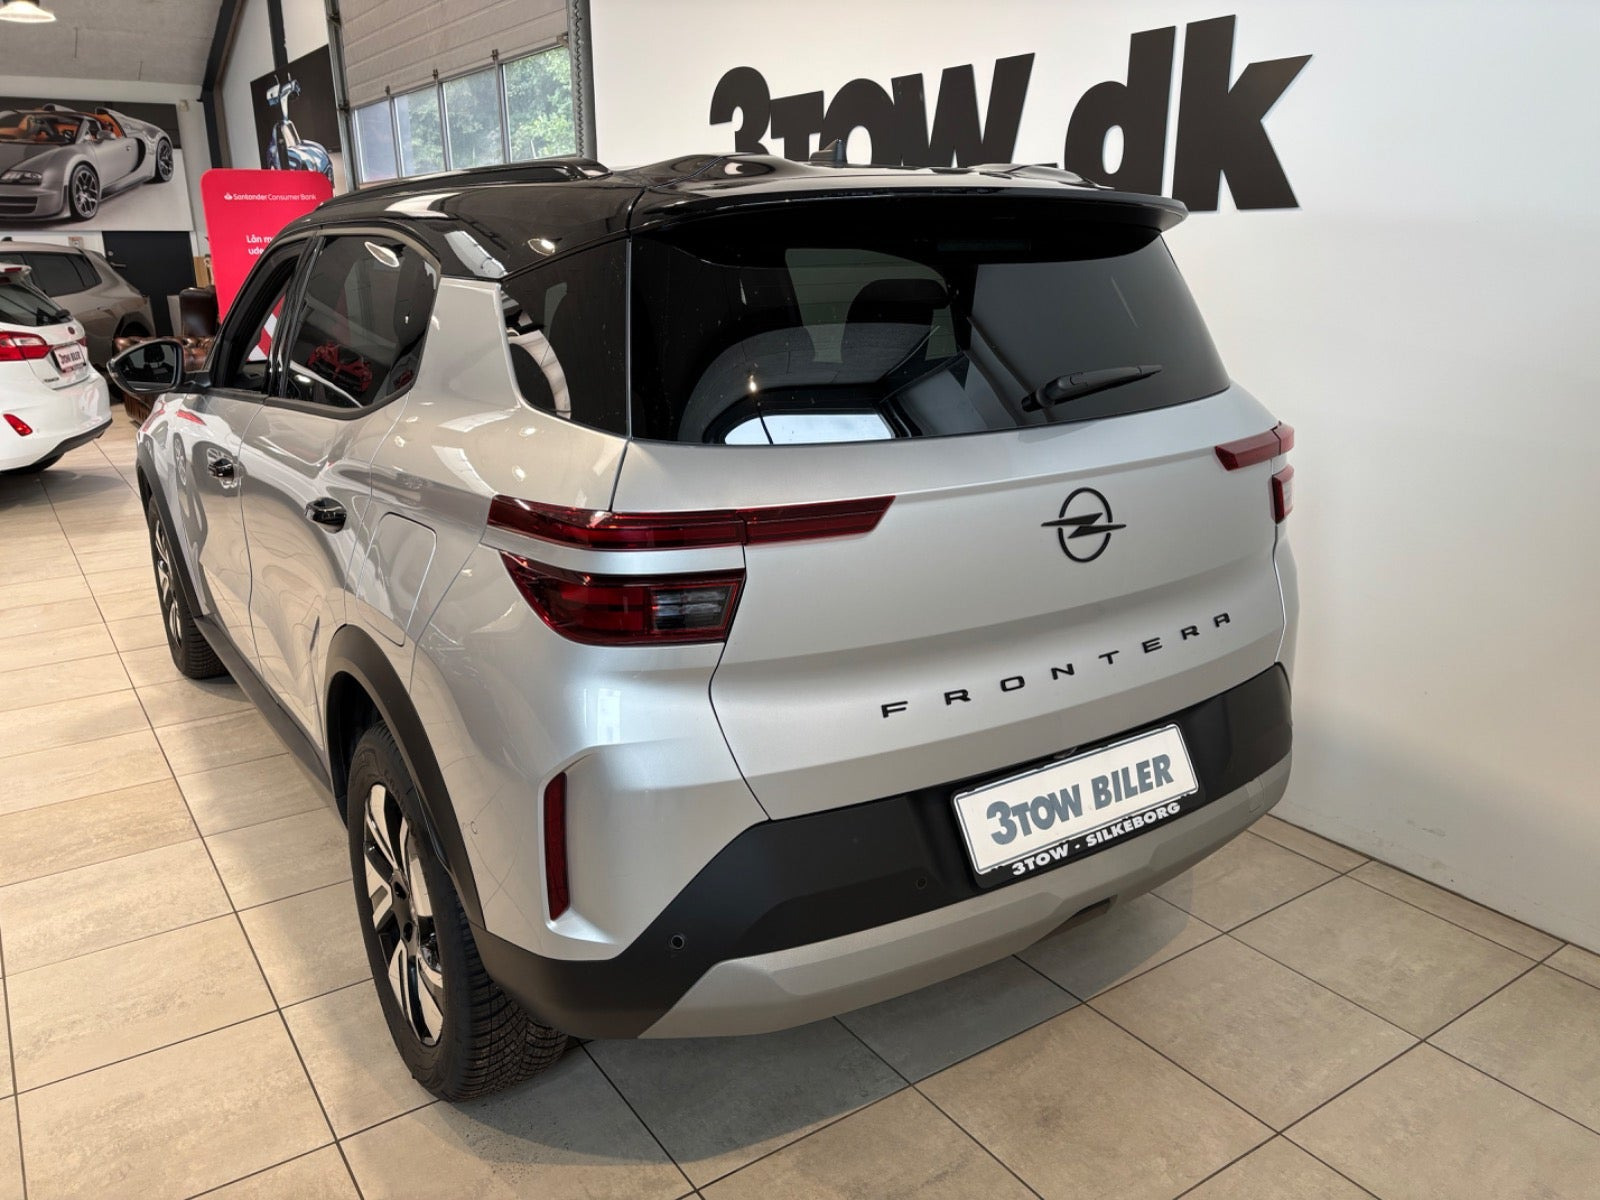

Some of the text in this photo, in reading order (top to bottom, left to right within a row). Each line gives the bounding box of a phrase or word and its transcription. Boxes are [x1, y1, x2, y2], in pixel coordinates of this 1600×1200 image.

[708, 14, 1313, 211] 3TOWdk
[246, 234, 262, 243] Lån
[880, 611, 1231, 718] FRONTERA
[987, 753, 1175, 845] 3TOW BILER
[1012, 842, 1069, 876] 3TOW
[1085, 802, 1181, 848] SILKEBORG
